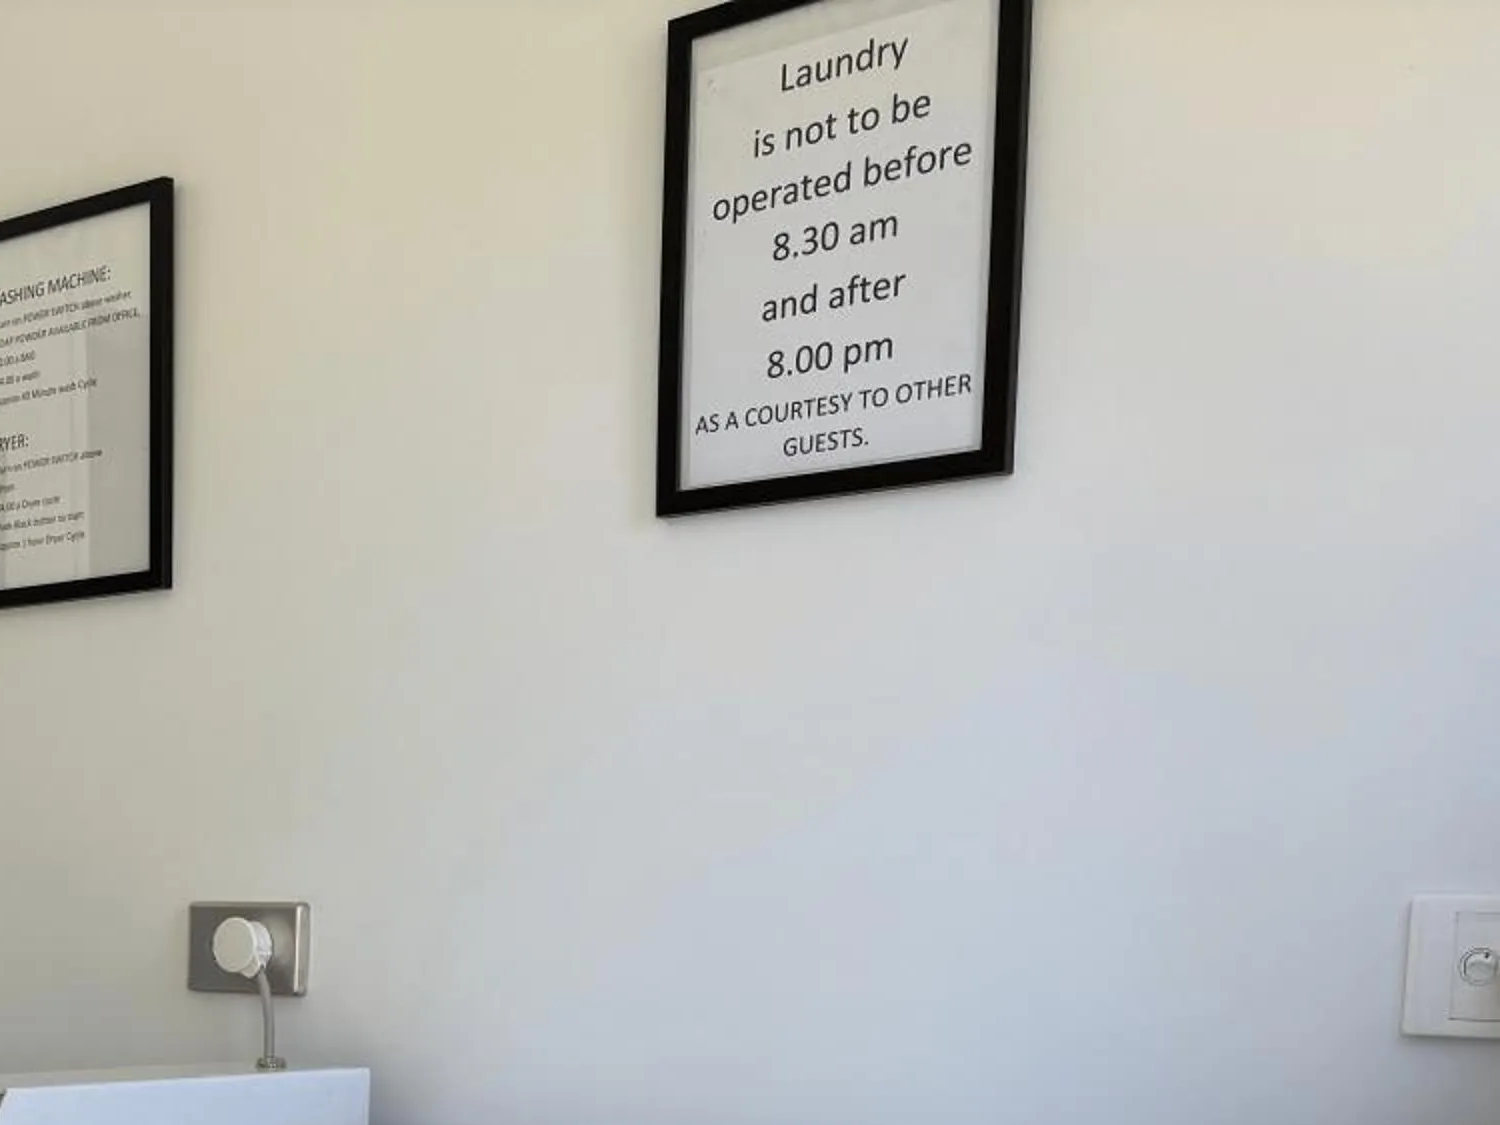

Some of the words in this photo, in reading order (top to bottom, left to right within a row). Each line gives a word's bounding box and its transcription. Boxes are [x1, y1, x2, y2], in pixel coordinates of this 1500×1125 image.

[780, 37, 908, 91] Laundry
[753, 129, 775, 158] is
[784, 113, 837, 150] not
[847, 105, 880, 135] to
[891, 93, 932, 125] be
[712, 162, 852, 224] operated
[863, 141, 973, 187] before
[772, 221, 840, 262] 8.30
[849, 214, 899, 245] am
[47, 264, 111, 294] MACHINE:
[761, 284, 818, 322] and
[828, 271, 907, 309] after
[767, 341, 833, 379] 8.00
[842, 336, 894, 374] pm
[695, 413, 720, 435] AS
[724, 410, 740, 430] A
[745, 390, 854, 428] COURTESY
[858, 386, 890, 410] TO
[895, 373, 973, 406] OTHER
[783, 427, 869, 458] GUESTS.
